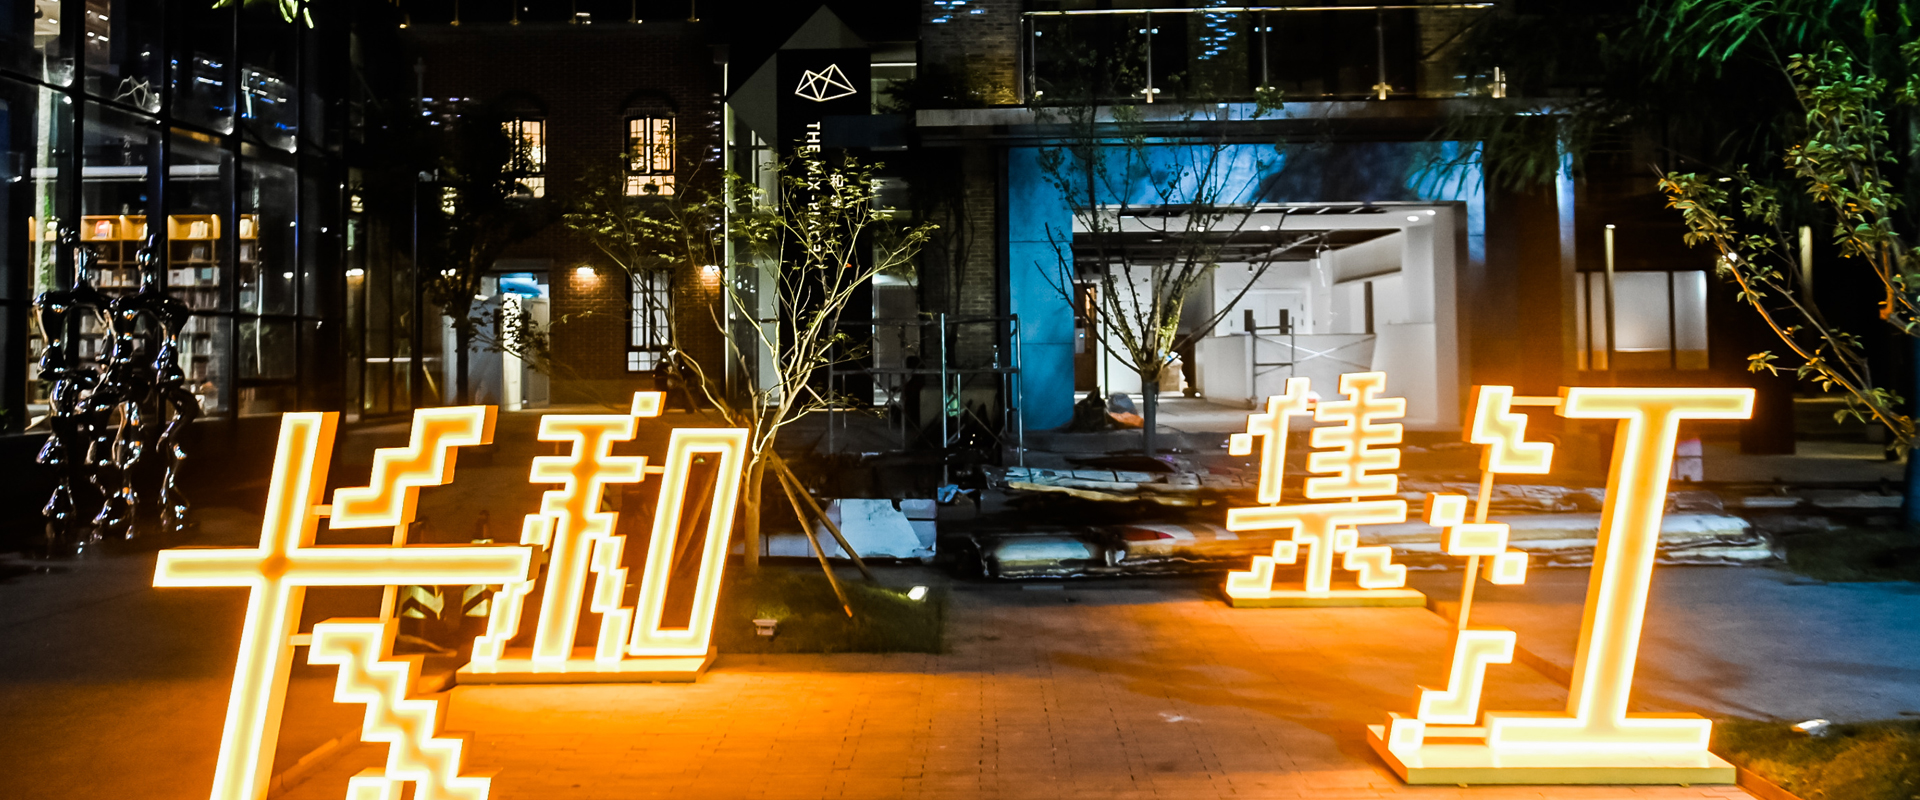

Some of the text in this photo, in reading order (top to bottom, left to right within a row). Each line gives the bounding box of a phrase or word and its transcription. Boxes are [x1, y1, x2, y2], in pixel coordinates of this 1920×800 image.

[806, 121, 821, 153] THE
[471, 391, 750, 664] 和
[1226, 371, 1407, 598] 集
[1385, 385, 1756, 751] 江
